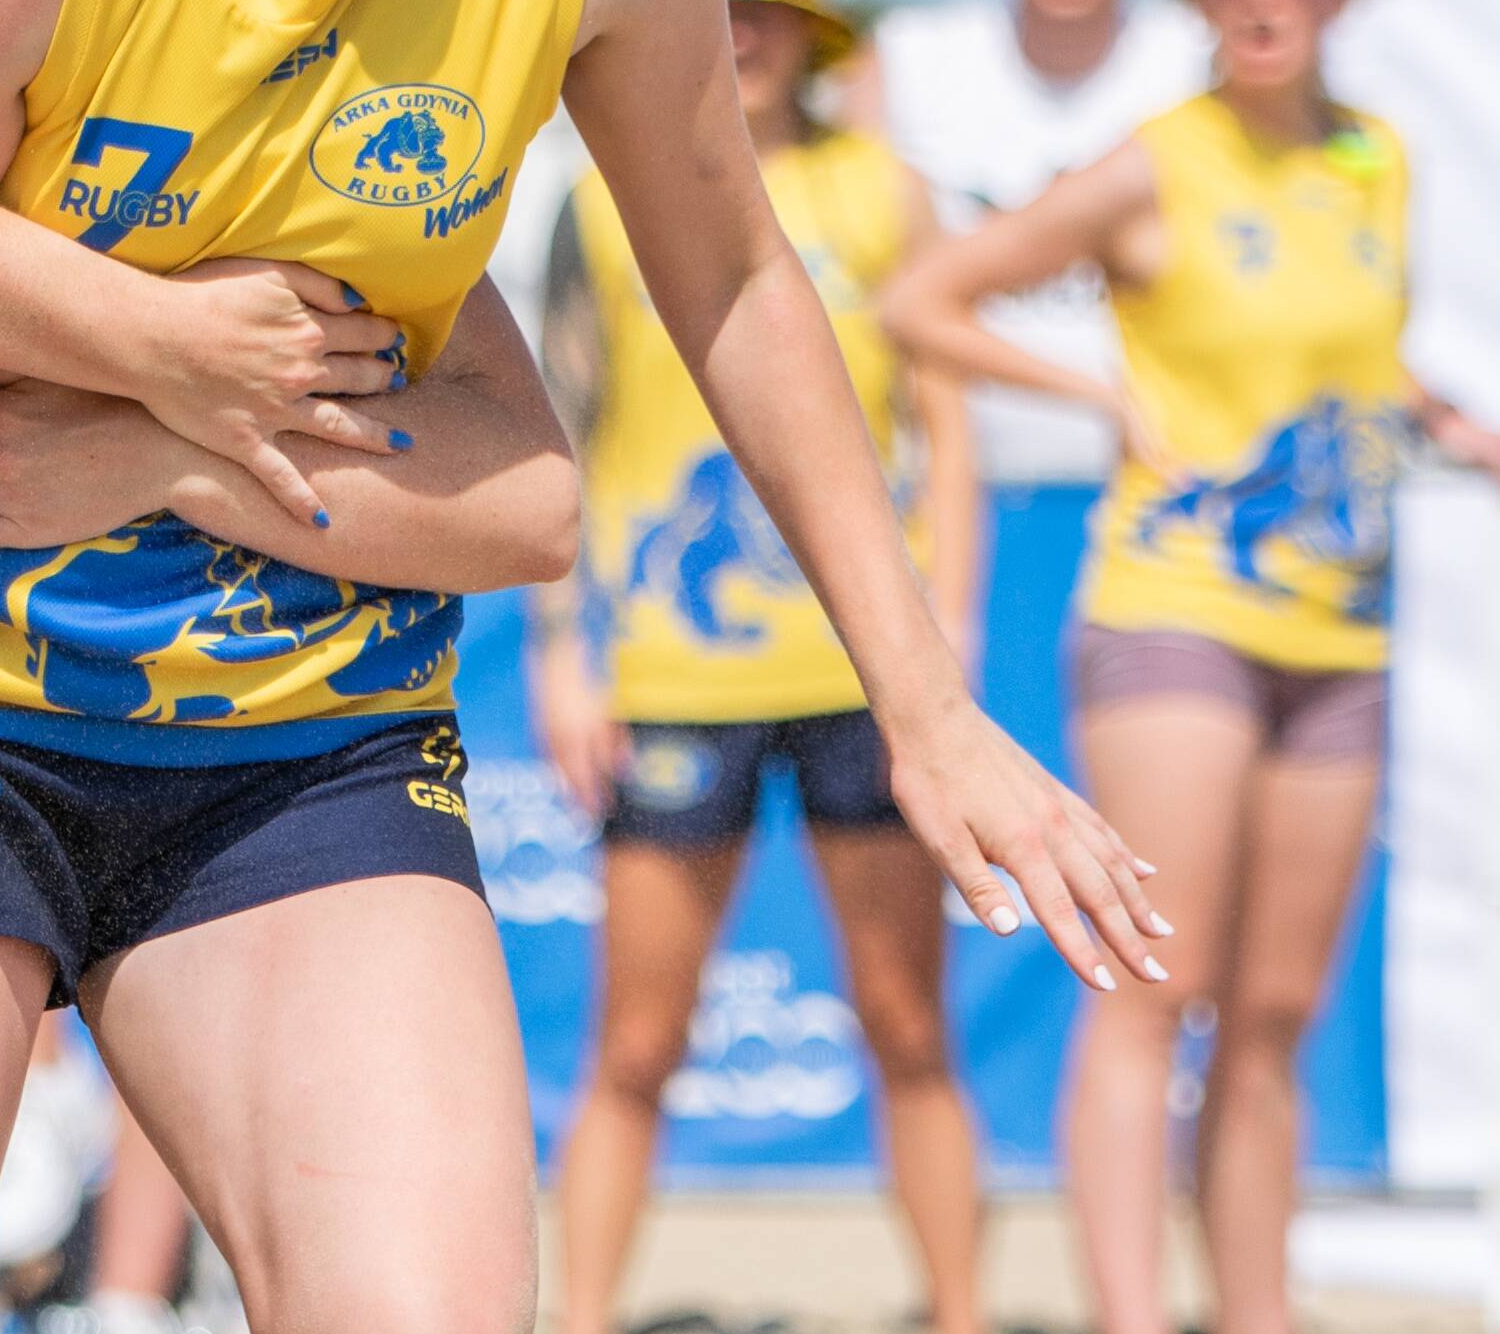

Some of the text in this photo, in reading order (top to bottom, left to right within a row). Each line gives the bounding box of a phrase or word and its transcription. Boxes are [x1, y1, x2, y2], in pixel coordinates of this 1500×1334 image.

[332, 94, 472, 133] ARKA GDYNIA
[59, 178, 201, 228] RUGBY
[72, 117, 194, 254] 7
[346, 172, 447, 202] RUGBY
